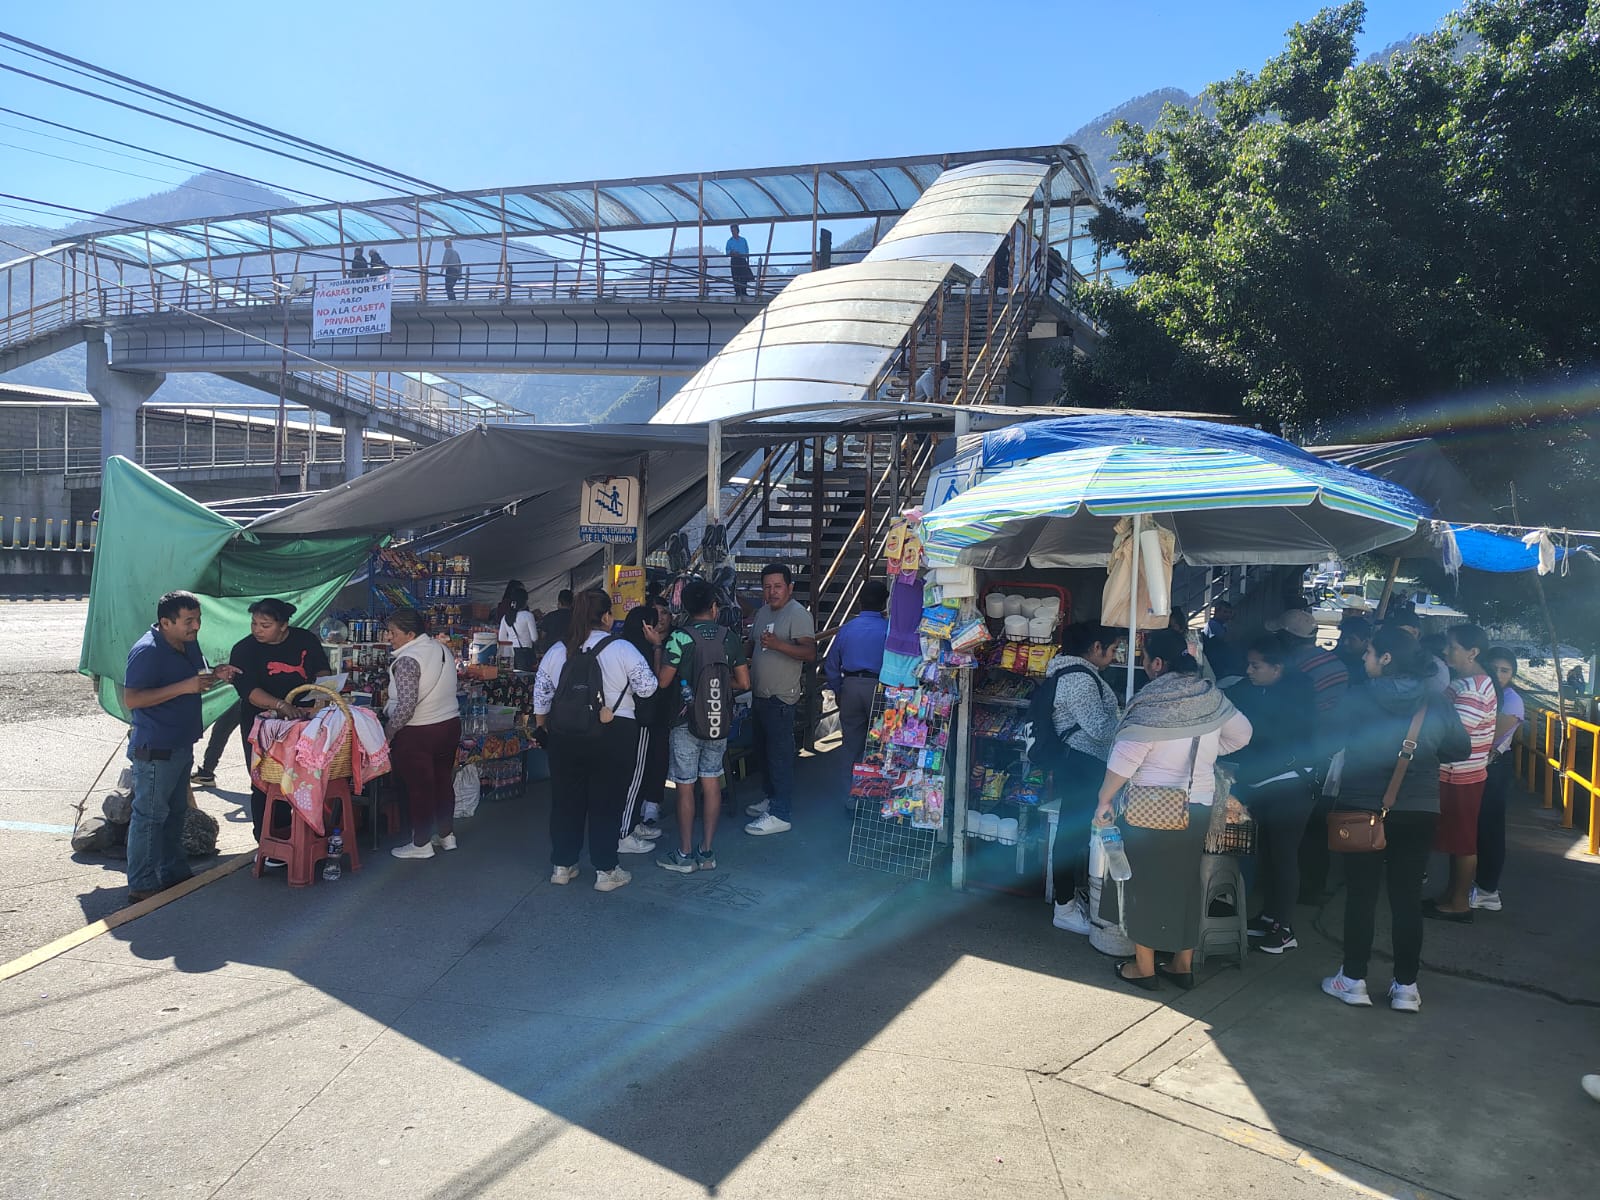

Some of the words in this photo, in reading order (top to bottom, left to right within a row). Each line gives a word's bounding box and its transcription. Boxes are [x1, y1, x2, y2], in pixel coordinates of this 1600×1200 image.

[352, 286, 370, 294] POR
[372, 282, 391, 292] ESTE
[316, 308, 330, 317] NO
[331, 307, 337, 316] A
[338, 306, 350, 314] LA
[351, 302, 386, 313] CASETA
[324, 315, 363, 326] PRIVADA
[364, 314, 377, 322] EN
[582, 533, 593, 542] USE
[601, 534, 633, 544] PASAMANOS
[707, 678, 722, 738] adidas
